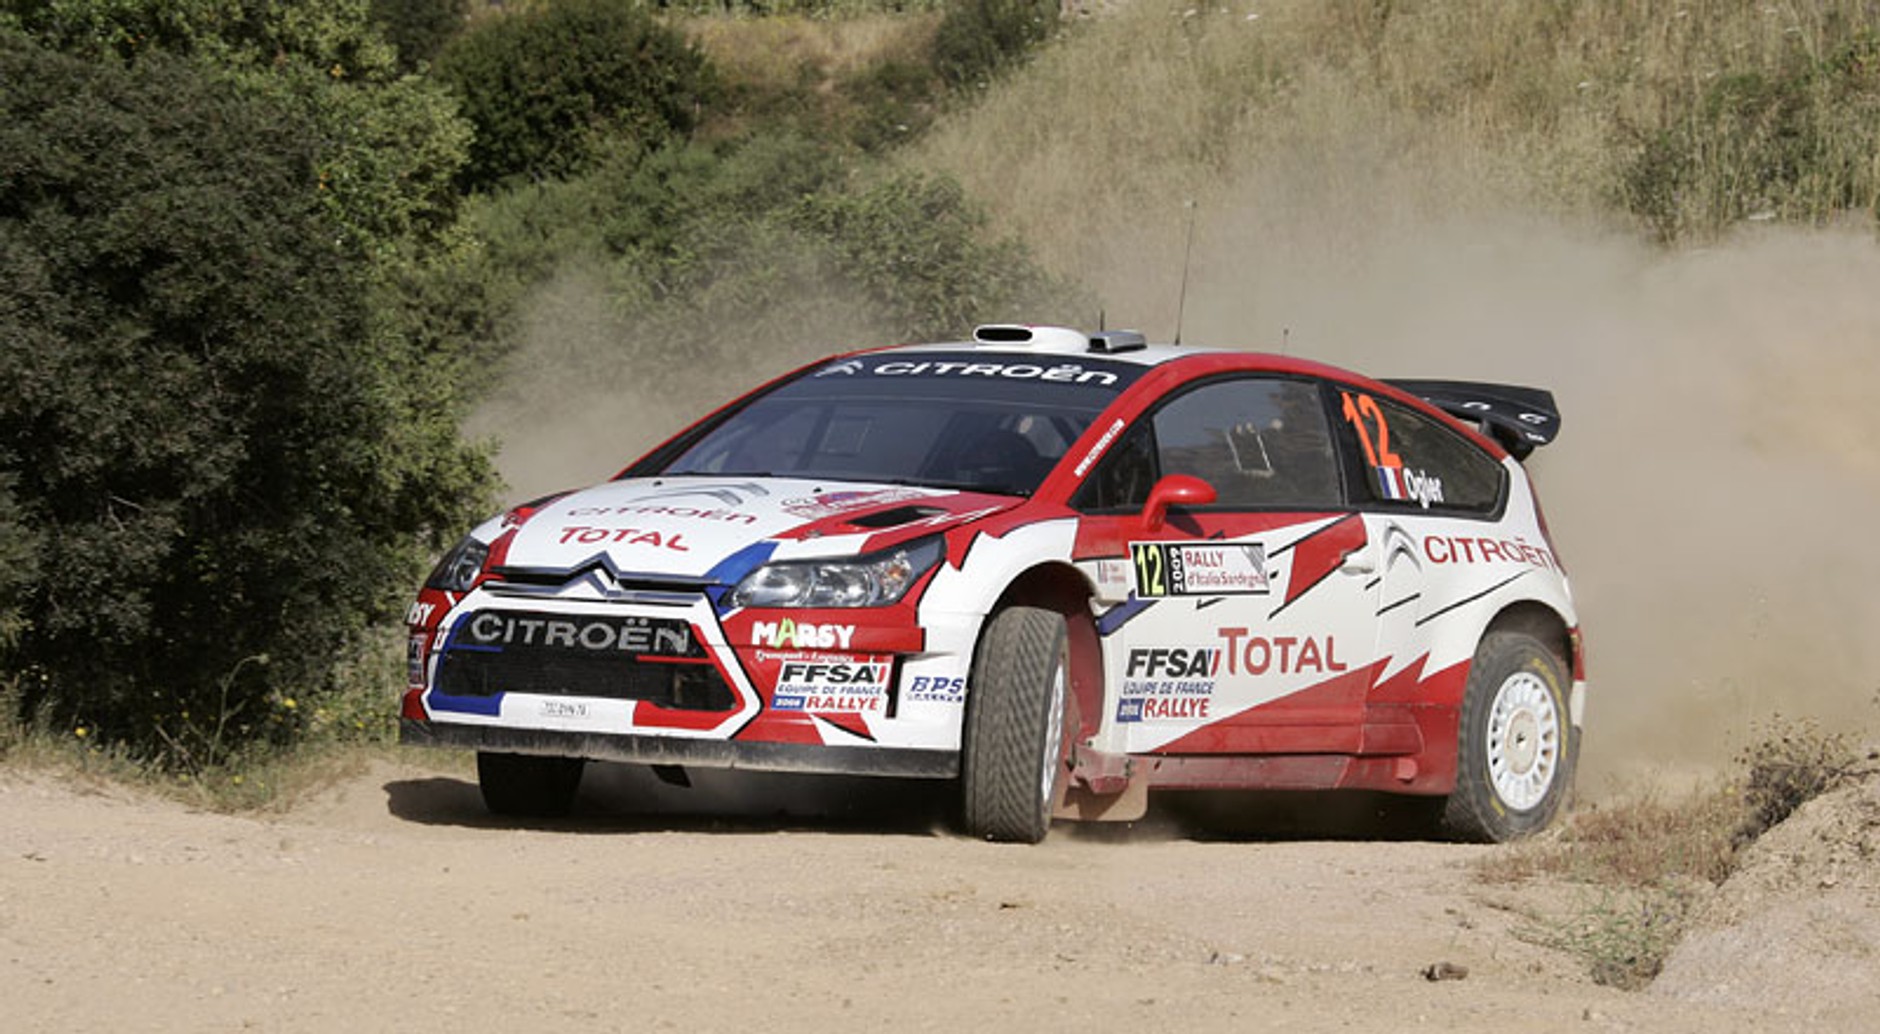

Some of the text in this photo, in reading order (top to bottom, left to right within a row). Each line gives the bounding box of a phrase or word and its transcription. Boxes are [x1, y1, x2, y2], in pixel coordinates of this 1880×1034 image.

[1341, 392, 1402, 467] 12
[558, 526, 690, 552] TOTAL
[1136, 545, 1165, 596] 12
[1185, 551, 1224, 567] RALLY
[471, 613, 690, 652] CITROËN
[752, 618, 855, 650] MARSY
[1126, 649, 1208, 677] FFSA
[1218, 627, 1347, 676] TOTAL
[782, 664, 875, 683] FFSA
[911, 676, 964, 694] BPS
[822, 685, 838, 694] DE
[840, 686, 883, 695] FRANCE
[1159, 682, 1173, 694] DE
[1175, 682, 1214, 694] FRANCE
[806, 695, 880, 710] RALLYE
[1144, 698, 1210, 718] RALLYE
